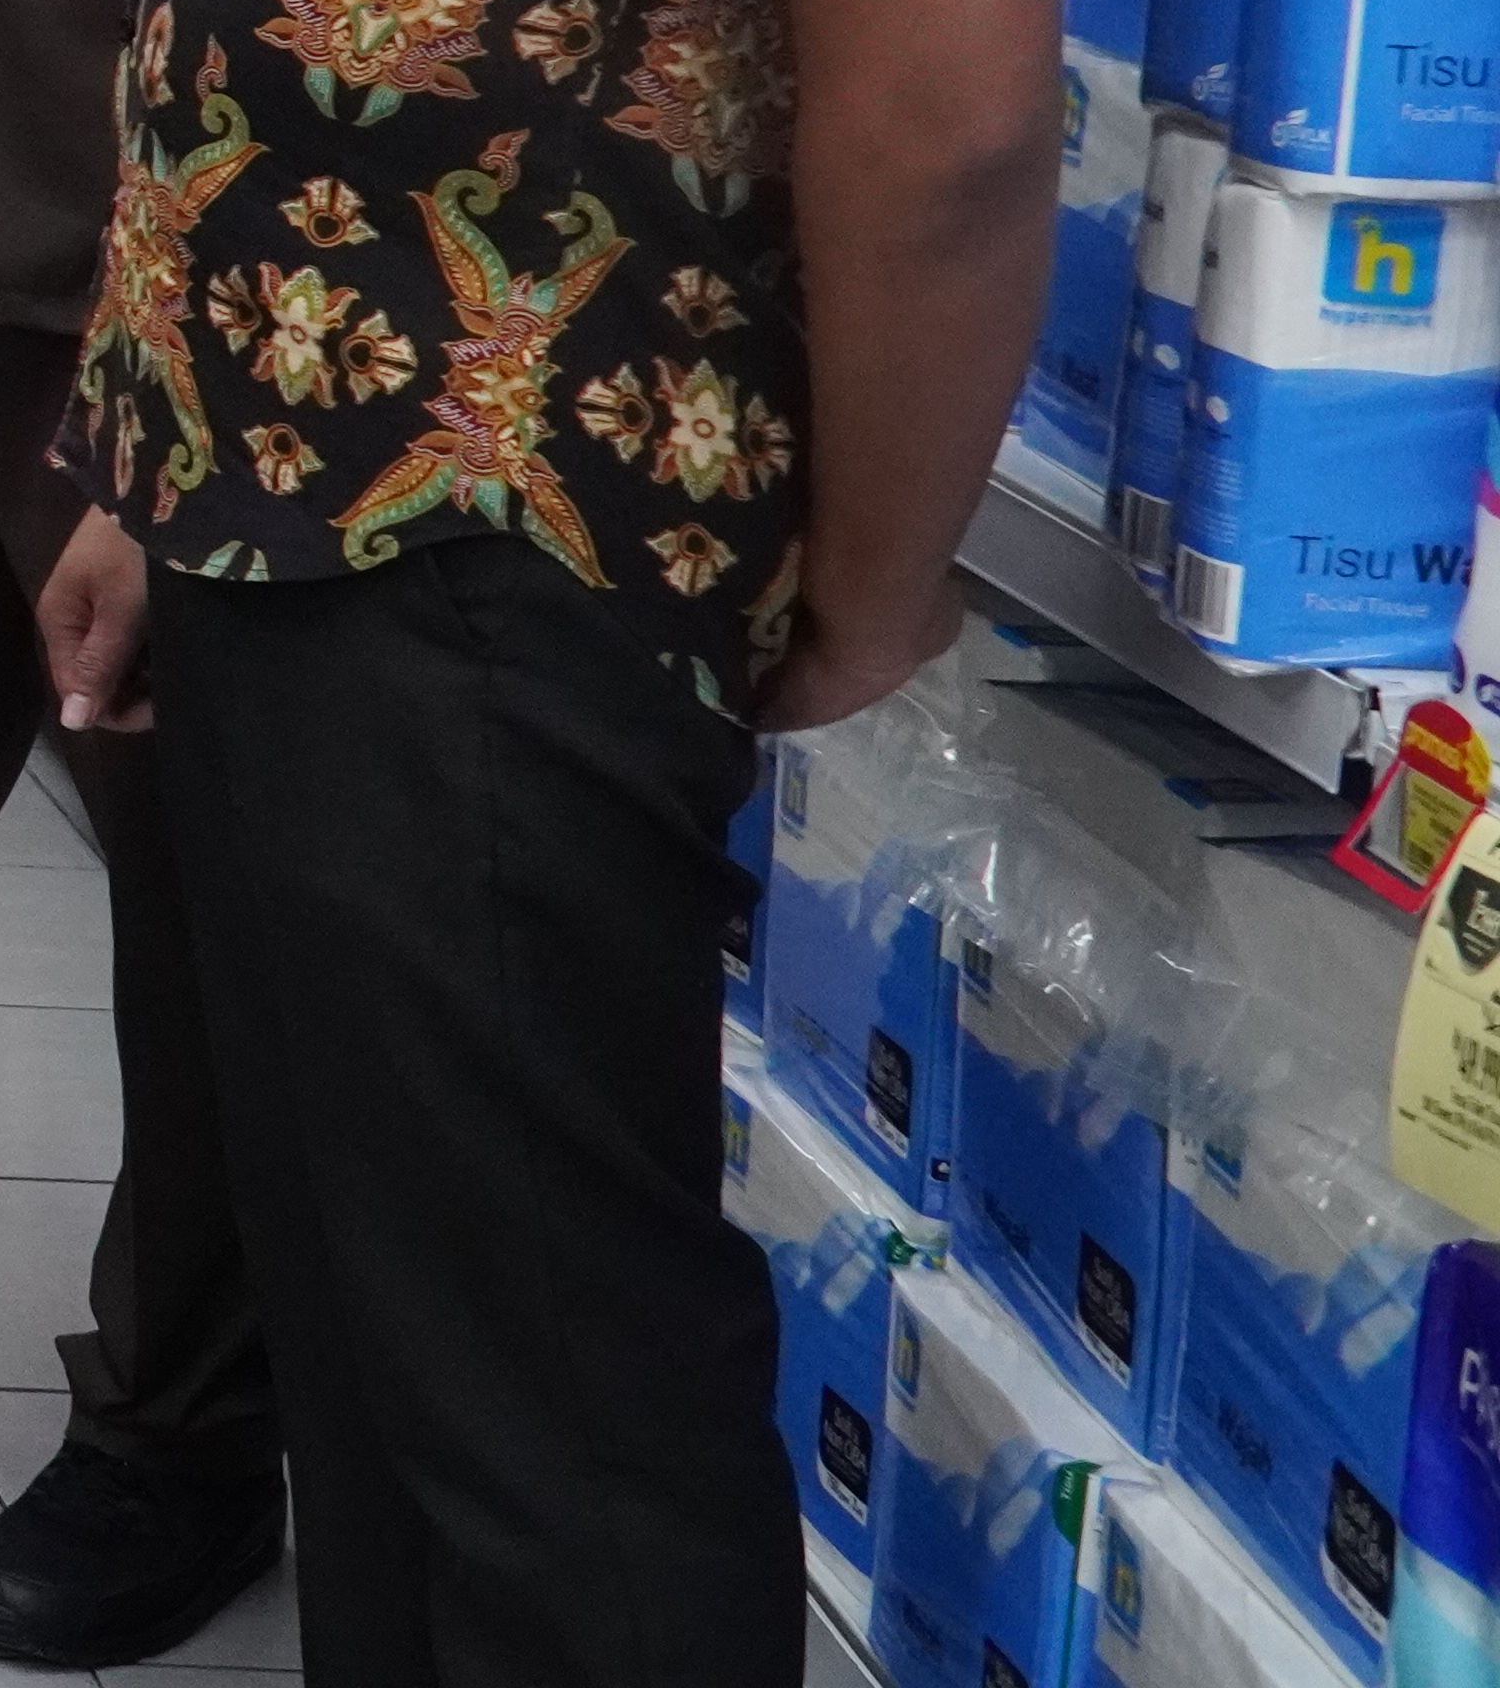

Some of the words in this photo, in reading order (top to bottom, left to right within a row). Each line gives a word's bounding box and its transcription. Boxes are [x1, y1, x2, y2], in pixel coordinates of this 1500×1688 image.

[1387, 41, 1490, 90] Tisu
[1353, 216, 1418, 296] h
[1288, 532, 1397, 583] Tisu
